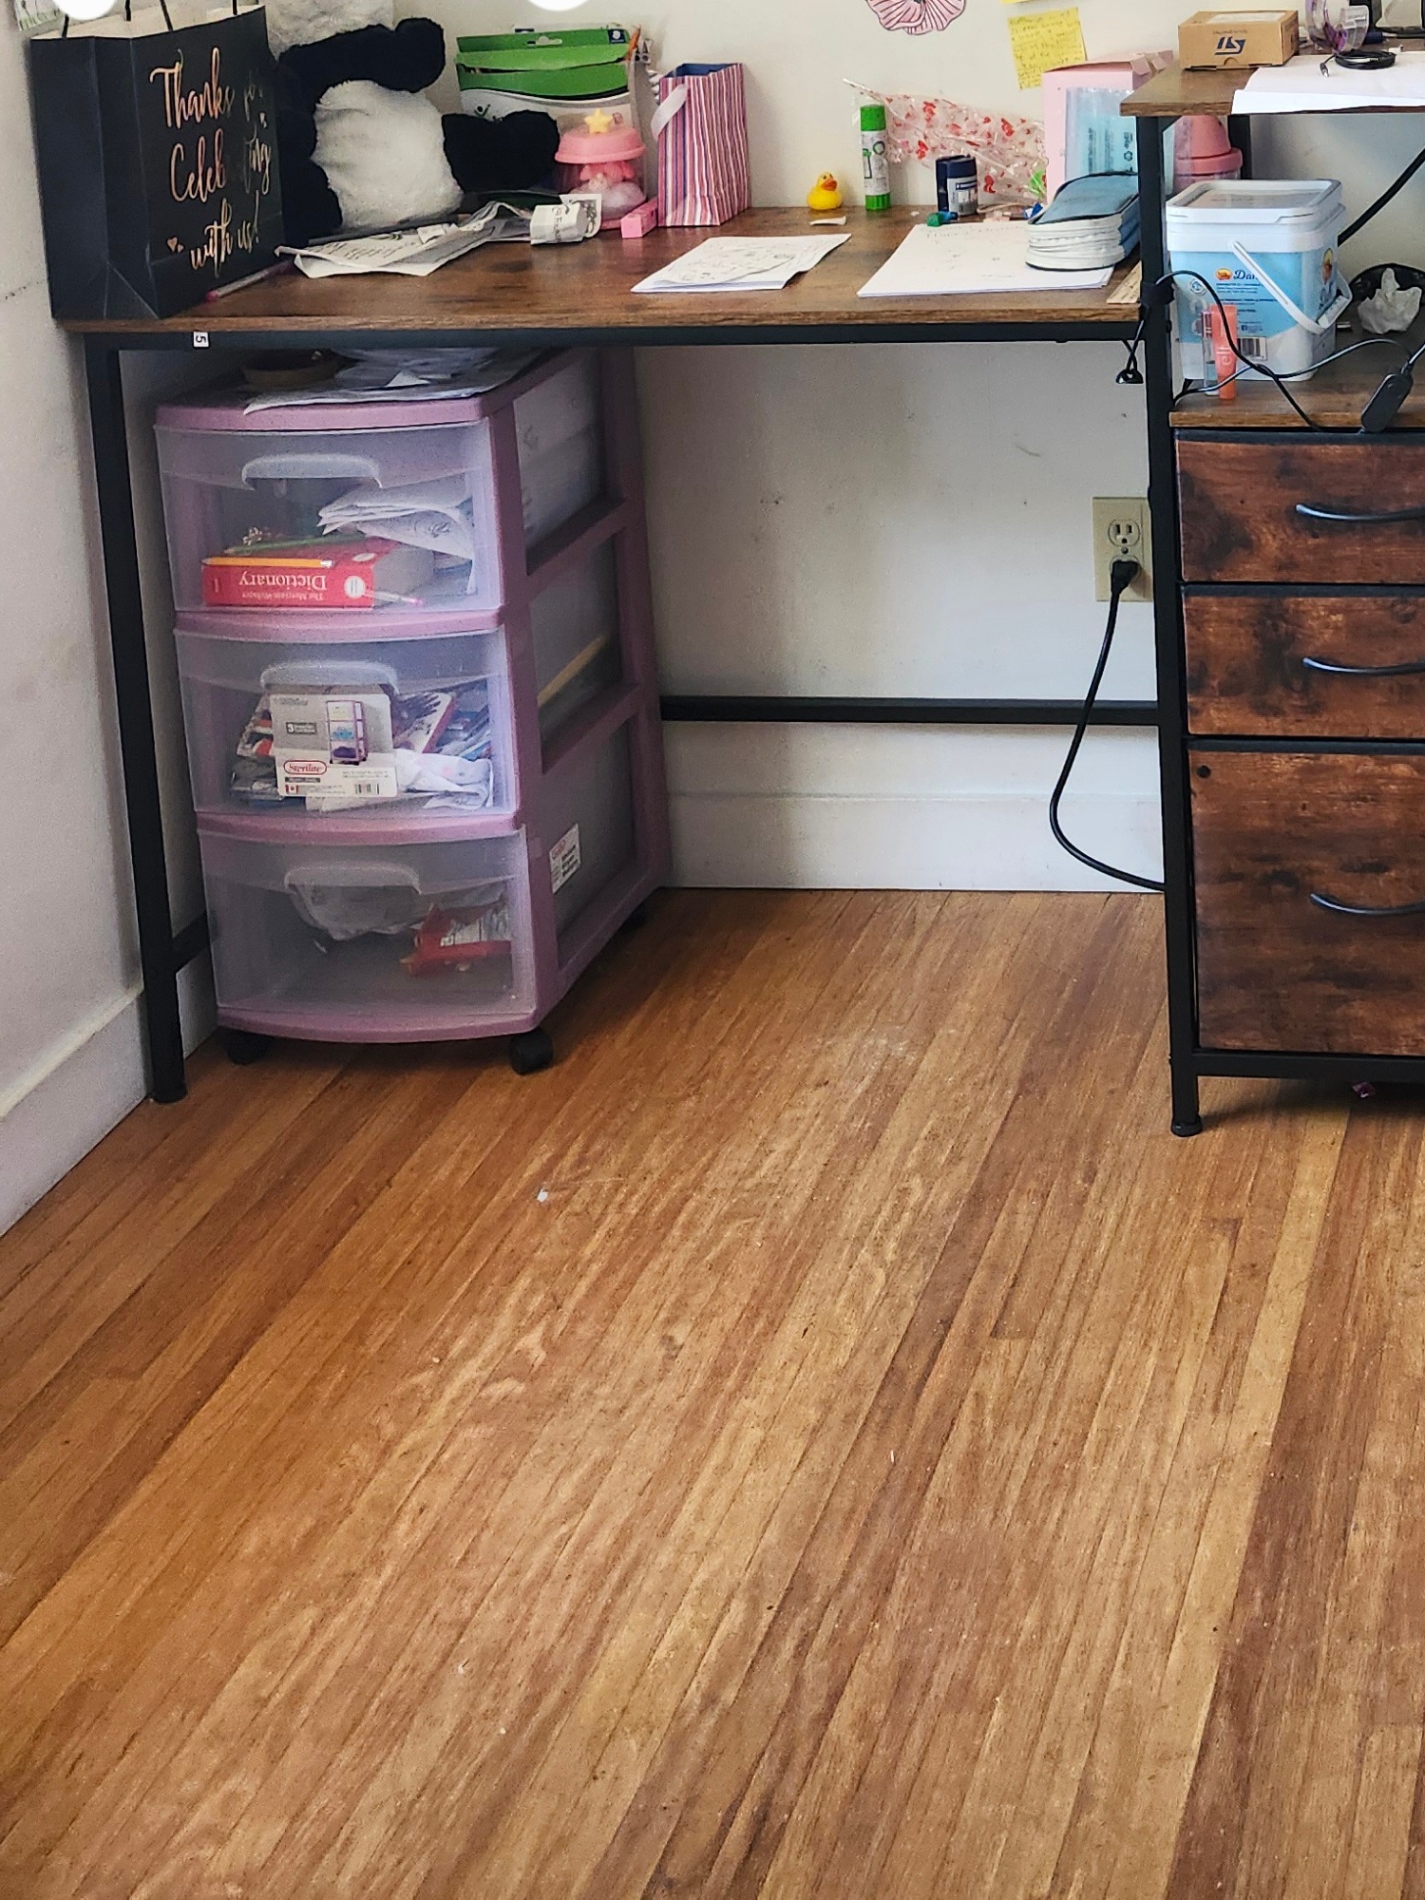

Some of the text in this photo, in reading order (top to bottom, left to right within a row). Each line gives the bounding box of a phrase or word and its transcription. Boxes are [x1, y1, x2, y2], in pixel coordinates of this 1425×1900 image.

[150, 47, 235, 129] Thanks
[190, 190, 260, 278] with us!
[195, 335, 206, 344] 5
[239, 570, 327, 591] Dictionary
